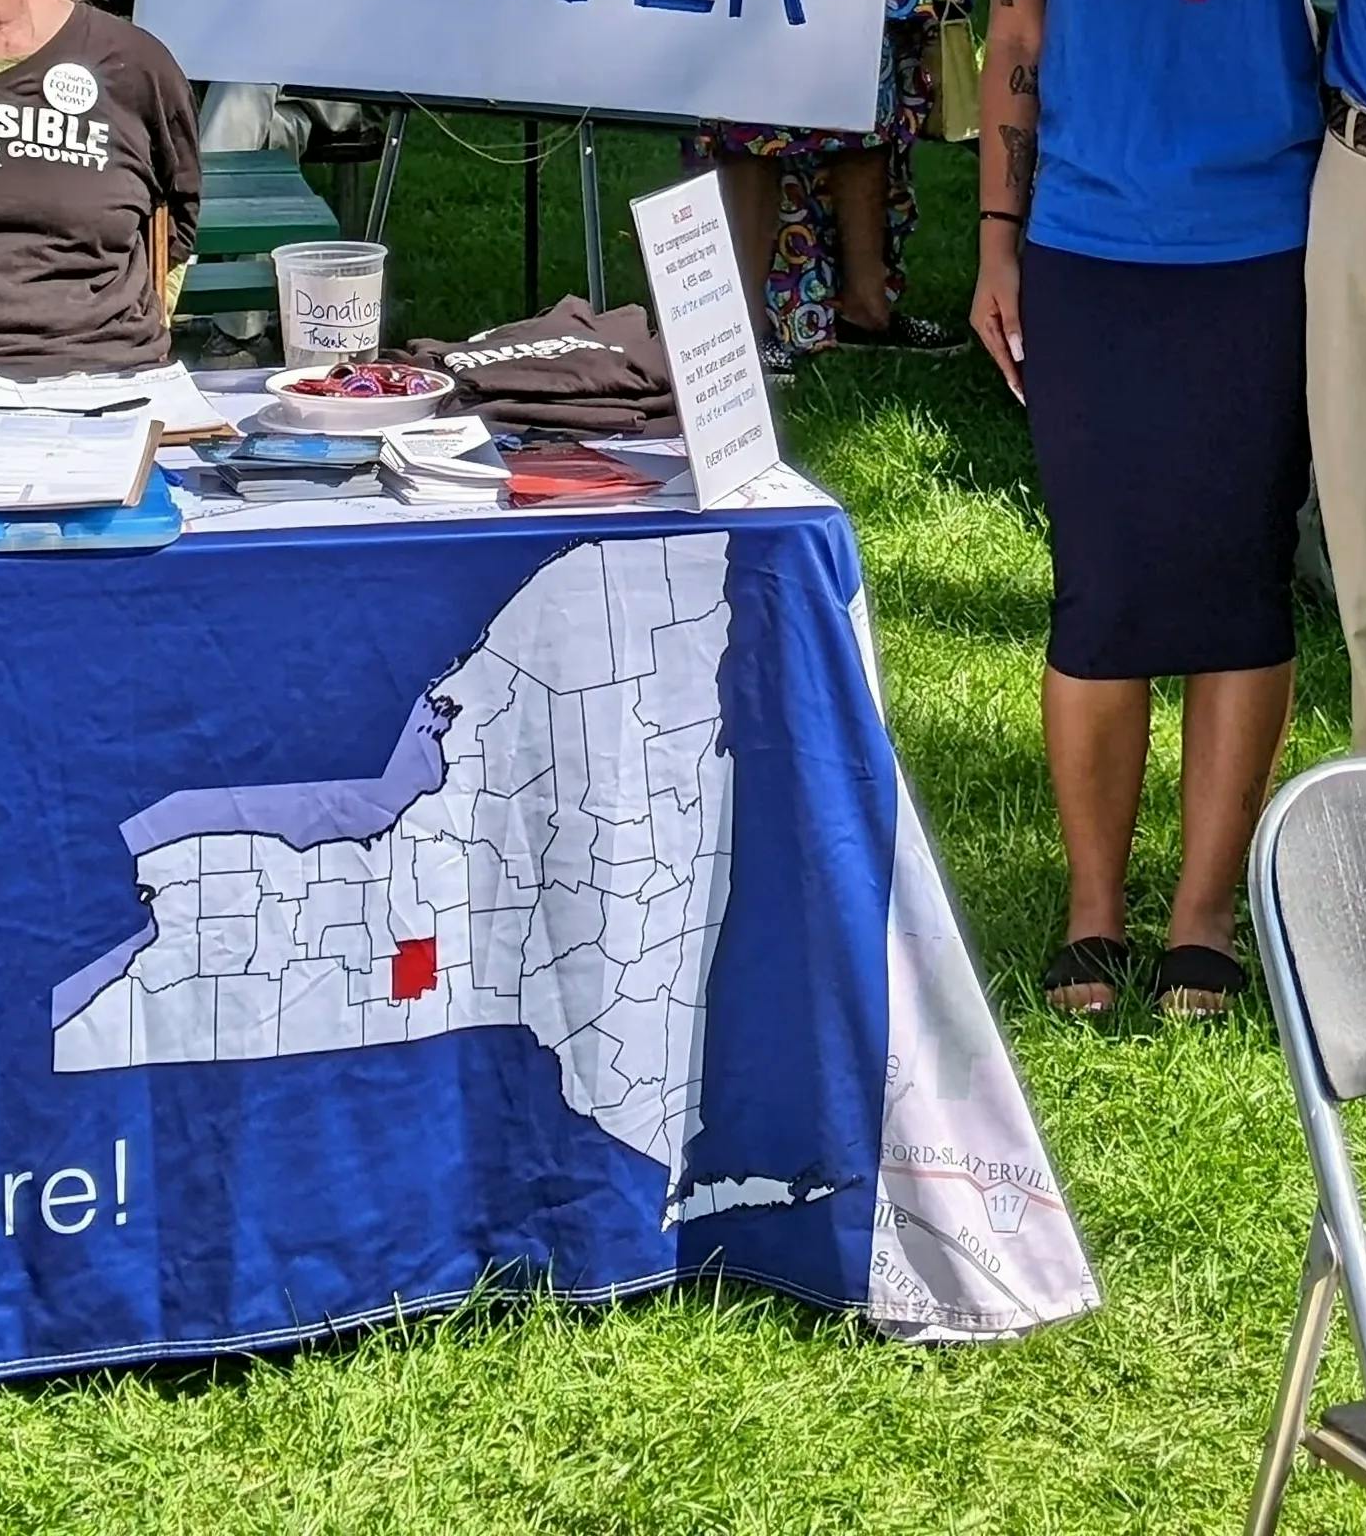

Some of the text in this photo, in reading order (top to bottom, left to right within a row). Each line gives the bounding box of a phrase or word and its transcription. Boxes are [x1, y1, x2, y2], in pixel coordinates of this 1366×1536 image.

[7, 141, 108, 171] COUNTY
[303, 328, 347, 348] Thank
[990, 1195, 1020, 1213] 117
[957, 1226, 1001, 1274] ROAD
